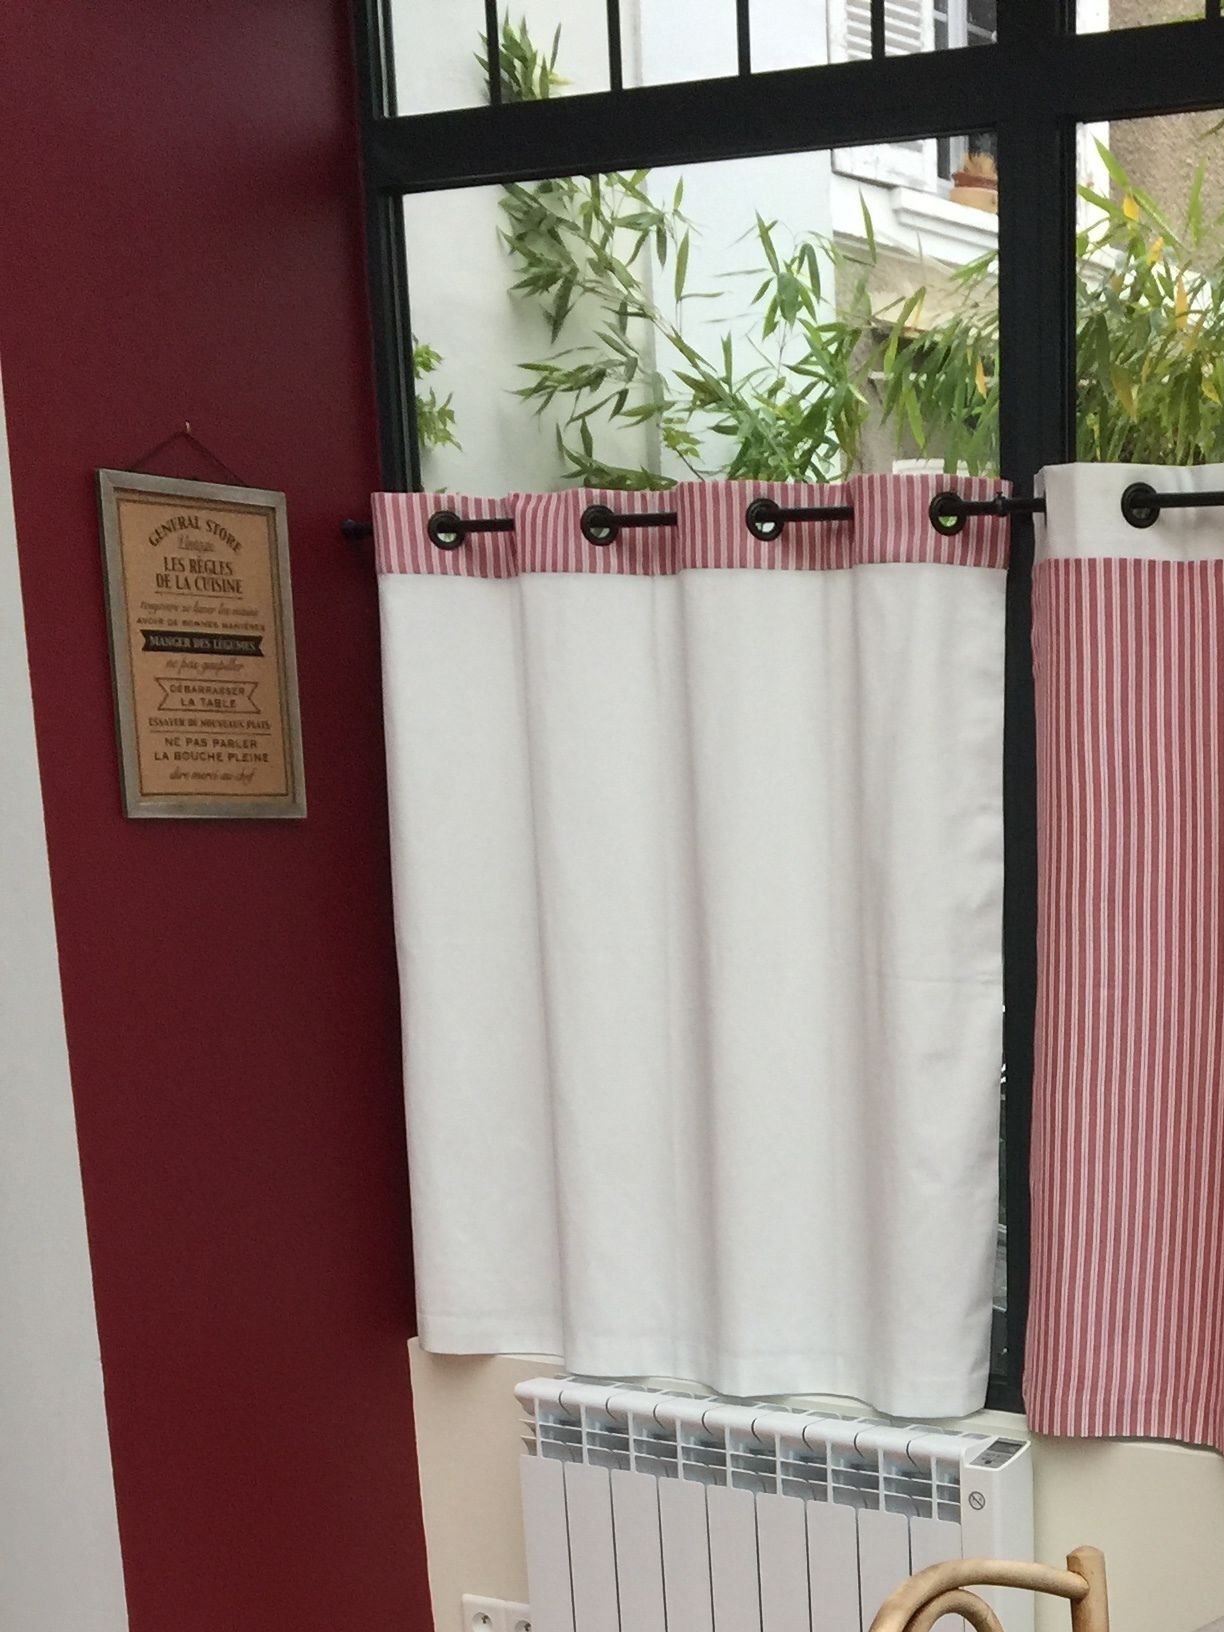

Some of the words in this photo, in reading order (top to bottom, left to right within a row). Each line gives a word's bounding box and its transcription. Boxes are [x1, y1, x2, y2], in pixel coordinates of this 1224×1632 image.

[149, 516, 201, 547] GENERAL
[206, 519, 243, 553] STORE
[164, 556, 186, 572] LES
[189, 555, 234, 576] RÈGLES
[156, 573, 172, 589] DE
[175, 575, 192, 590] LA
[194, 576, 243, 594] CUISINE
[149, 635, 191, 649] MANGER
[192, 637, 211, 649] DES
[213, 637, 258, 652] LÉGUMES
[170, 683, 245, 696] DÉBARRASSER
[181, 697, 196, 707] LA
[199, 697, 238, 709] TABLE
[165, 737, 181, 747] NE
[186, 737, 208, 748] PAS
[212, 738, 258, 750] PARLER
[154, 751, 170, 761] LA
[174, 751, 224, 762] BOUCHE
[227, 752, 270, 763] PLEINE
